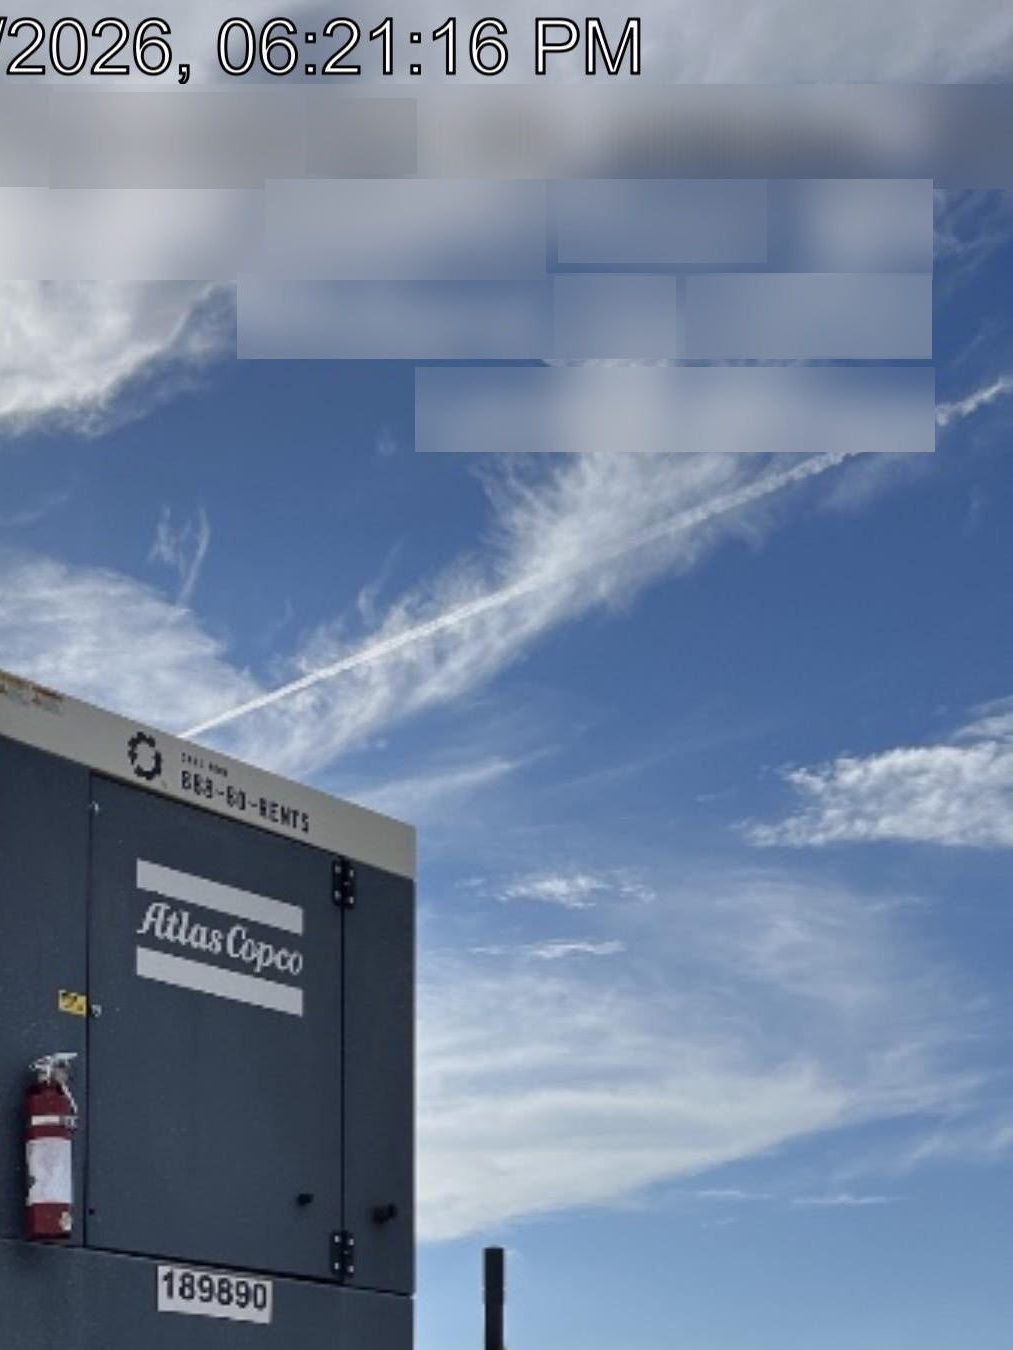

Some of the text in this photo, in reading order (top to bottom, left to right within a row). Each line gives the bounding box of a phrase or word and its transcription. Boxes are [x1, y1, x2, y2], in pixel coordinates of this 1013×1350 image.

[137, 902, 303, 976] Atlas Copco
[163, 1268, 268, 1312] 189890
